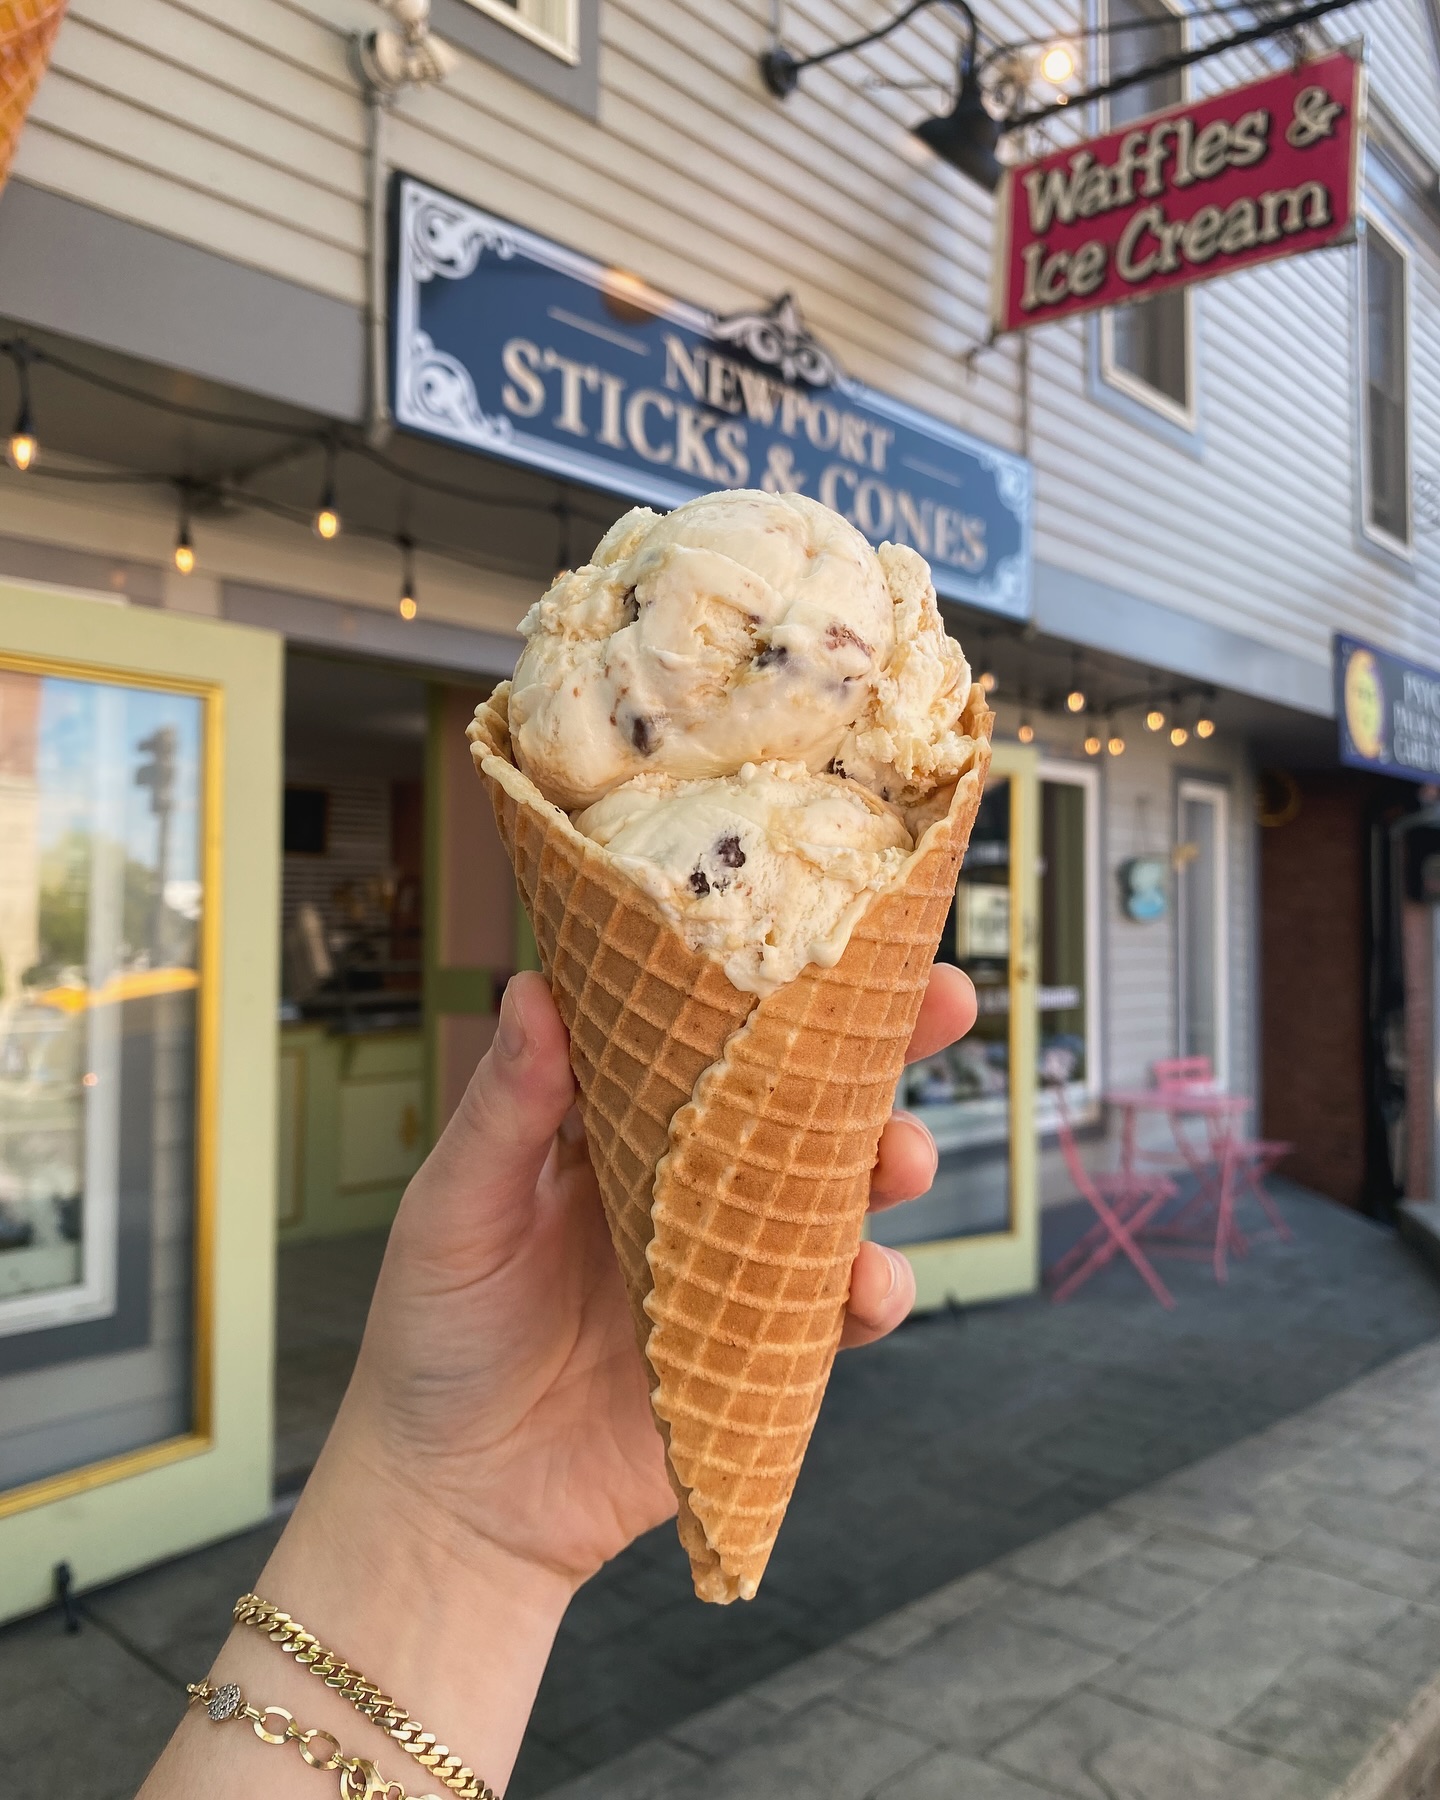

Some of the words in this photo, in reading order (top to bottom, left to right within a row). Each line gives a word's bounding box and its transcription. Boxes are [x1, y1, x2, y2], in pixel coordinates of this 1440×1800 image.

[1022, 108, 1270, 234] Waffles
[1285, 85, 1344, 148] &
[1020, 240, 1107, 312] Ice
[1115, 180, 1331, 283] Cream
[501, 336, 748, 487] STICKS
[760, 443, 806, 492] &
[819, 464, 987, 574] CONES
[662, 332, 895, 472] NEWPORT
